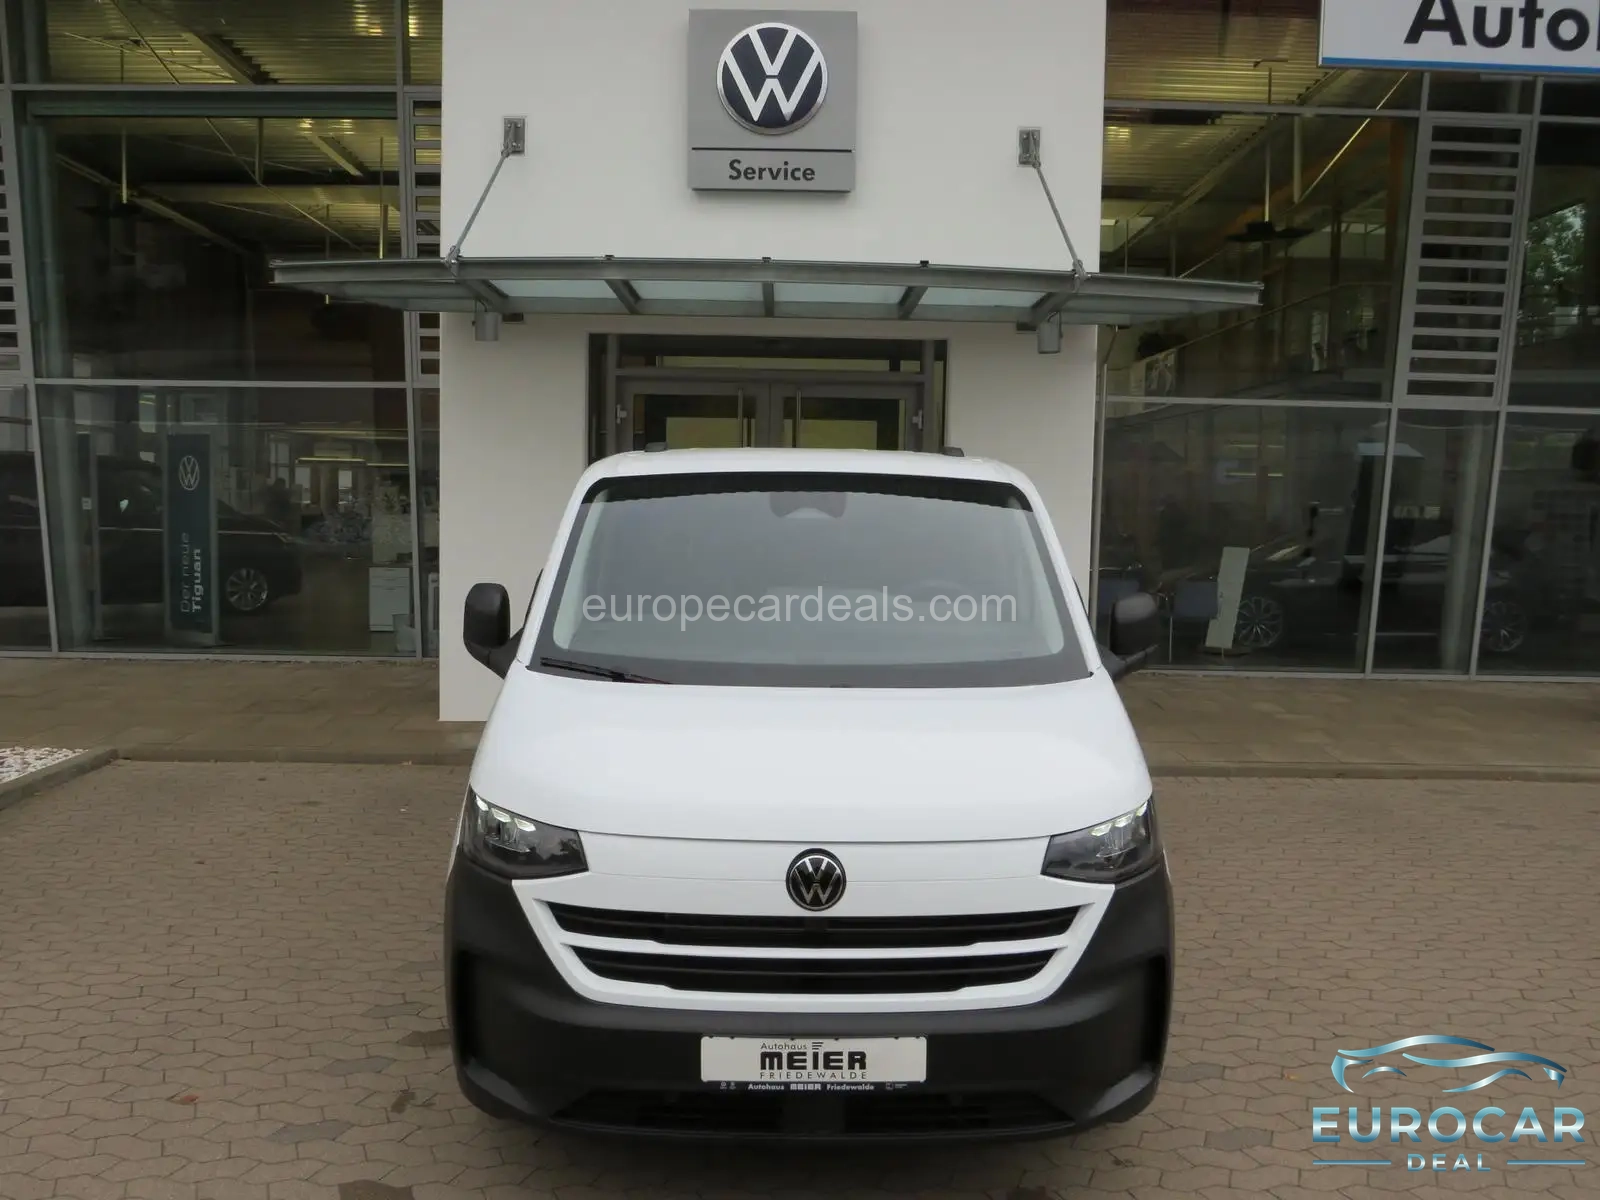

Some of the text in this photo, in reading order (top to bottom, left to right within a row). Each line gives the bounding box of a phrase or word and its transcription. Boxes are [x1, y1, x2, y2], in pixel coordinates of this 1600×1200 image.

[1404, 0, 1600, 51] Auto
[729, 159, 816, 182] Service
[180, 532, 190, 613] Der neue
[192, 549, 204, 613] Tiguan
[760, 1042, 807, 1051] Autohaus
[760, 1051, 867, 1070] MEIER
[760, 1071, 867, 1080] FRIEDEWALDE
[748, 1083, 875, 1091] Autohaus MEIER Friedewalde
